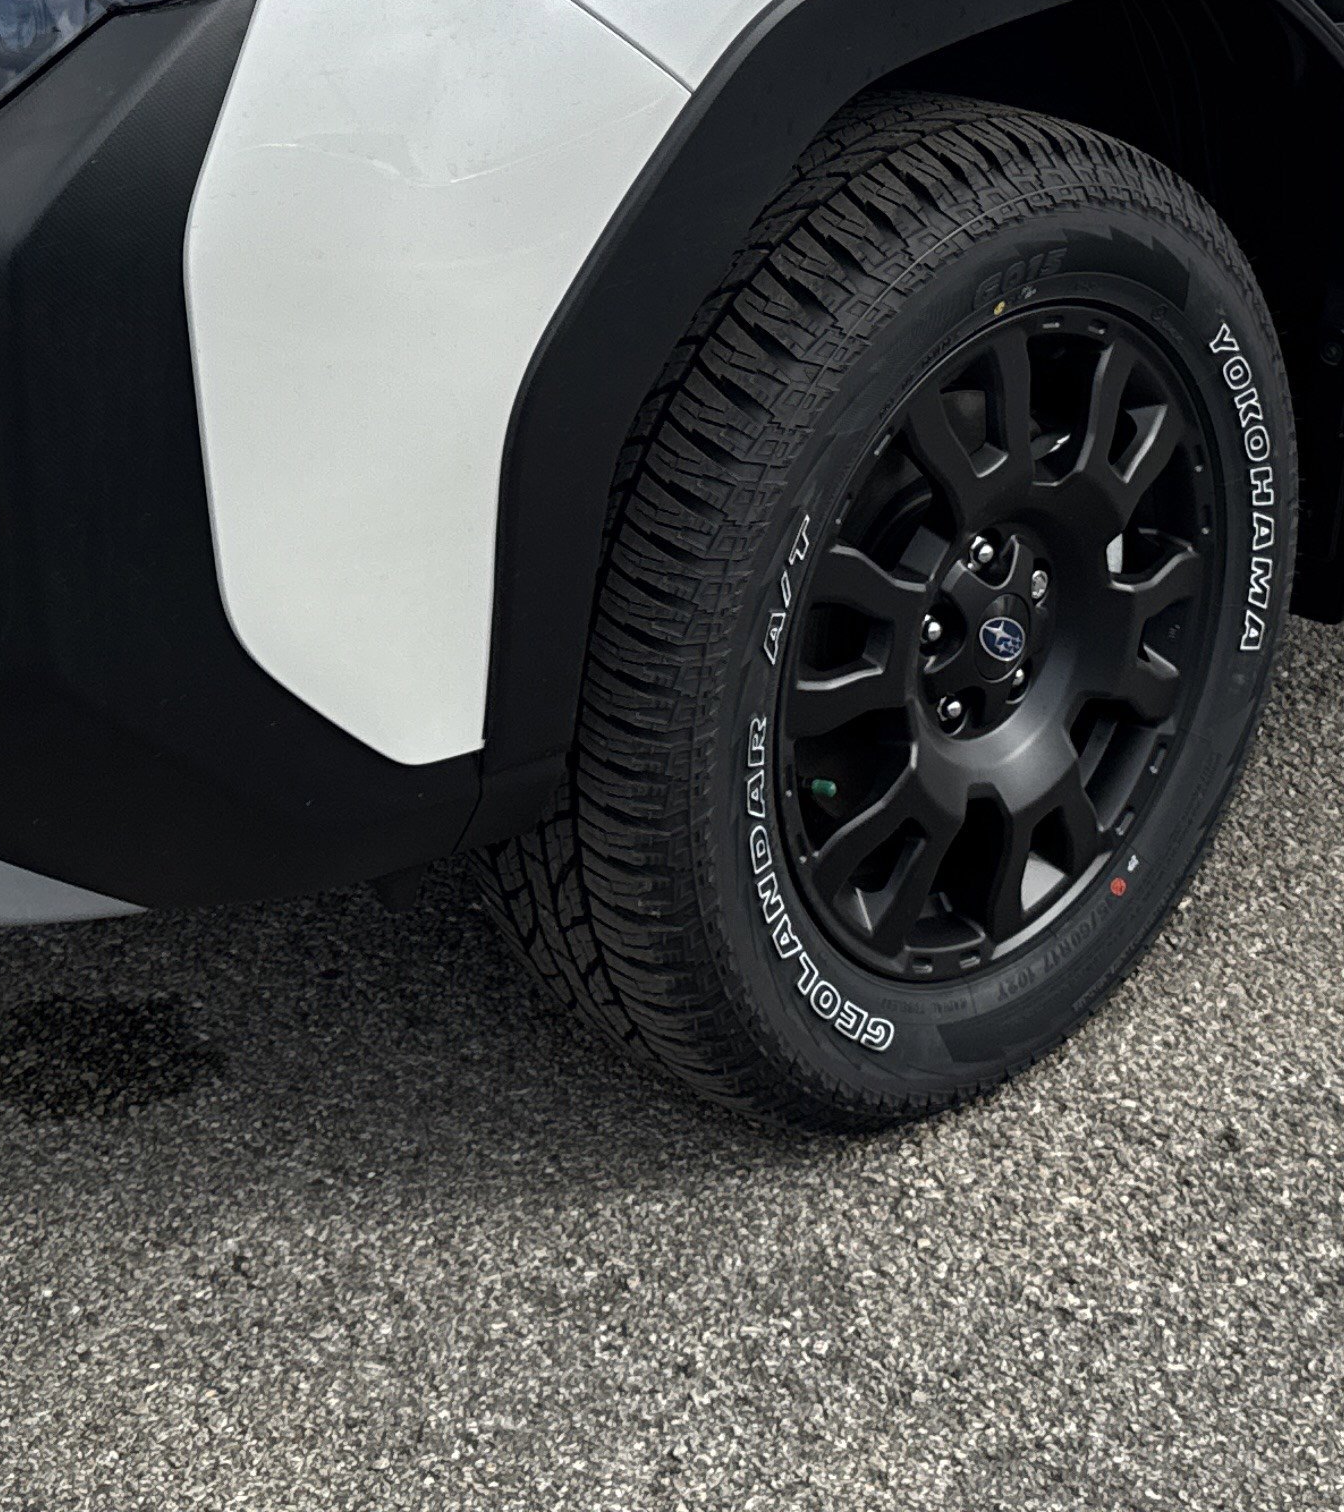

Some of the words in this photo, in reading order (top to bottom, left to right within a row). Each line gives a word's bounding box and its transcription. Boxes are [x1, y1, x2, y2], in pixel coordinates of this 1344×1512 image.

[764, 514, 810, 665] A/T
[1209, 323, 1275, 651] YOKOHAMA
[747, 715, 896, 1052] GEOLANDAR
